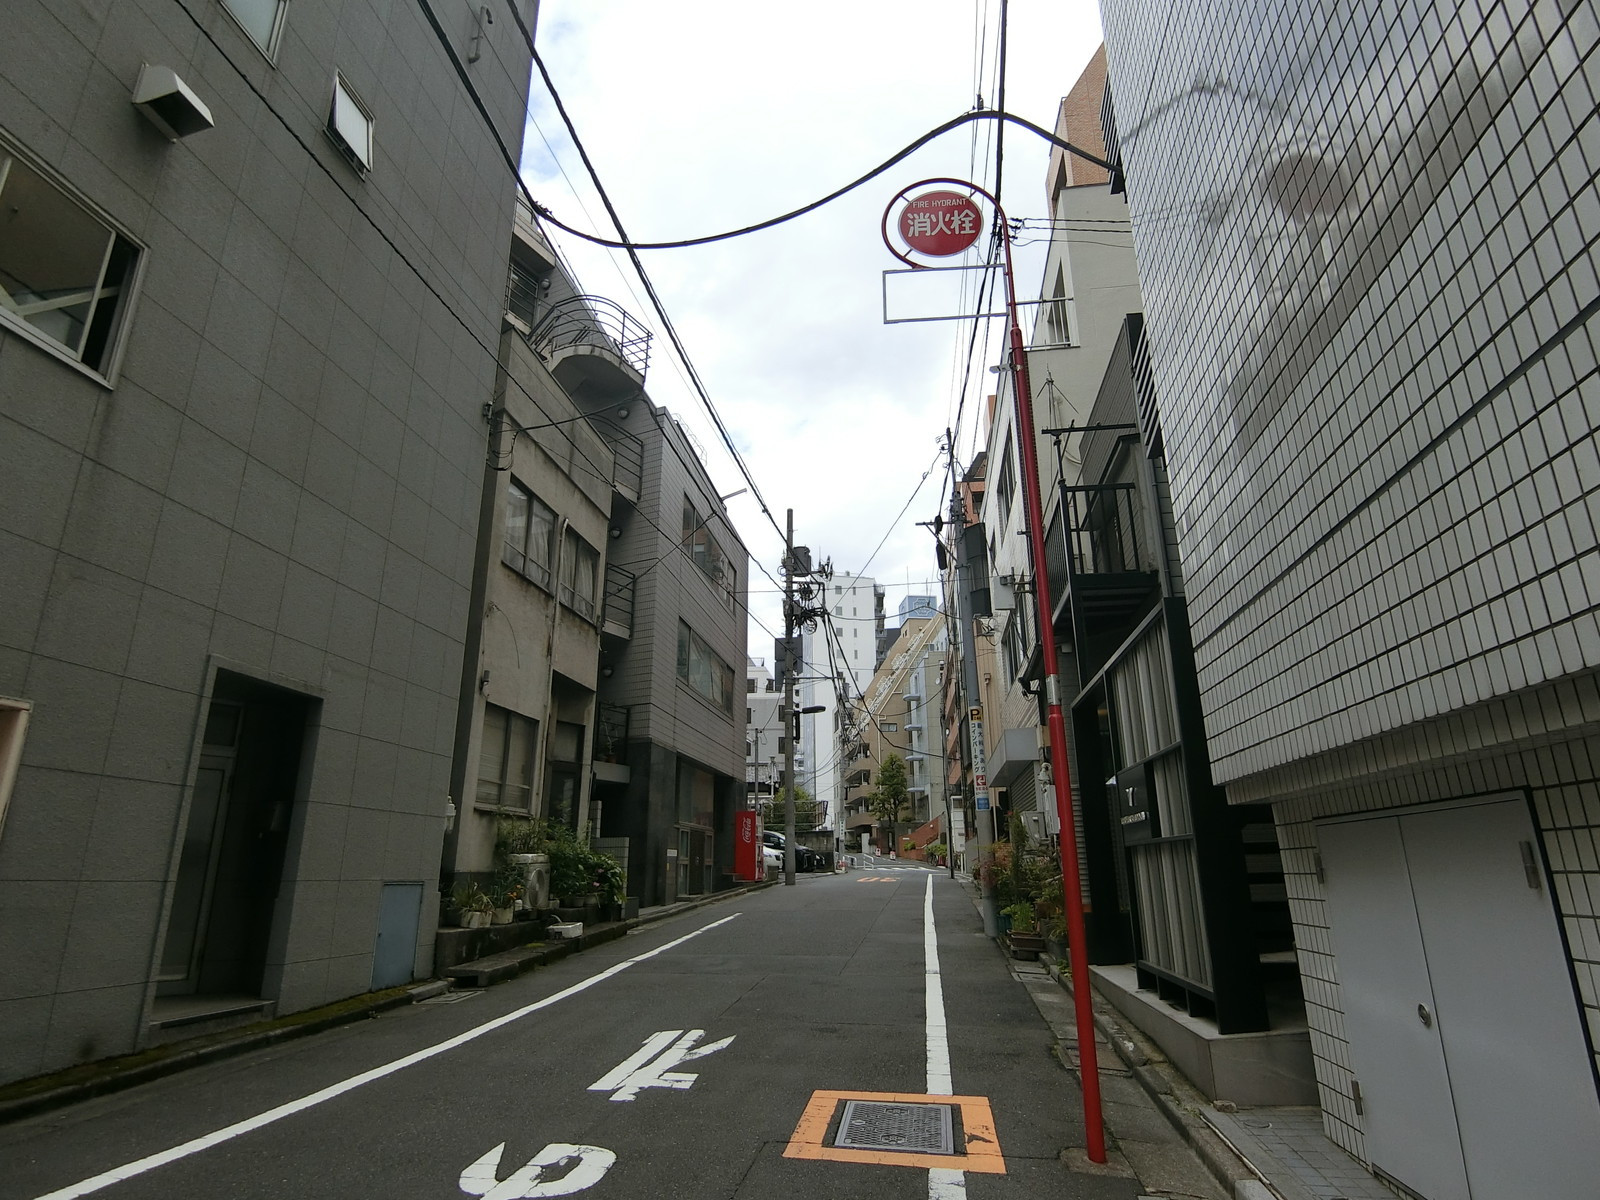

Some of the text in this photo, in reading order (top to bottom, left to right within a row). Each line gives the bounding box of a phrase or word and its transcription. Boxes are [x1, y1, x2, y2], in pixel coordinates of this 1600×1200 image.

[932, 199, 966, 207] HYDRANT
[907, 209, 976, 237] 消火栓
[970, 708, 980, 720] P
